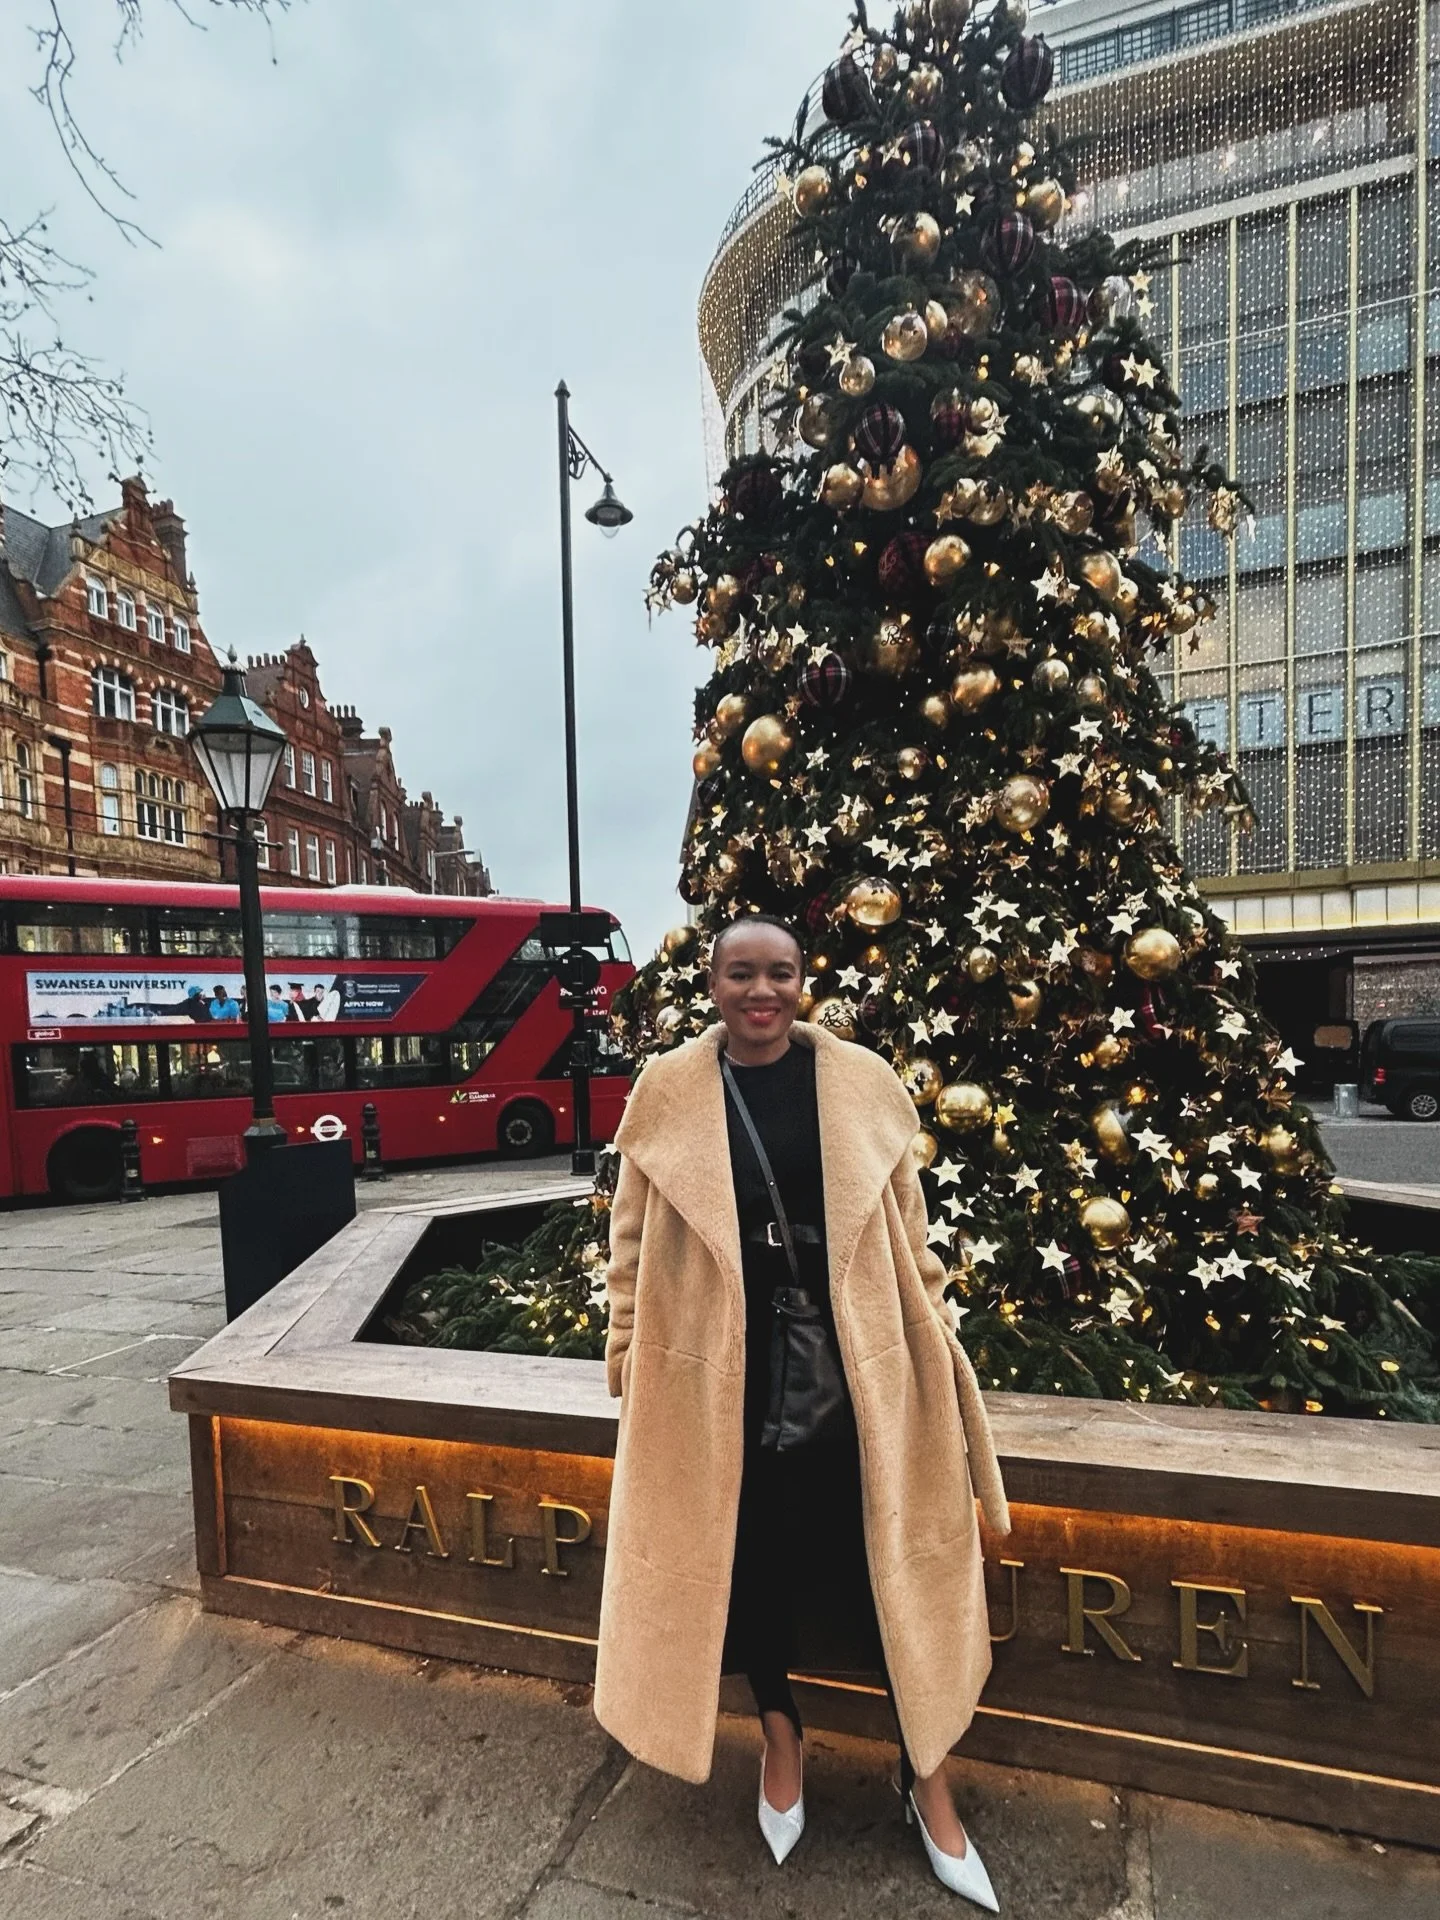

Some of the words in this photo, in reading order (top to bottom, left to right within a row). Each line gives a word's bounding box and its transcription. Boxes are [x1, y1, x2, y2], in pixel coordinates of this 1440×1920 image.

[1194, 685, 1395, 744] ETER
[35, 979, 106, 990] SWANSEA
[109, 979, 187, 990] UNIVERSITY
[329, 1475, 593, 1577] RALP
[990, 1558, 1385, 1699] UREN
